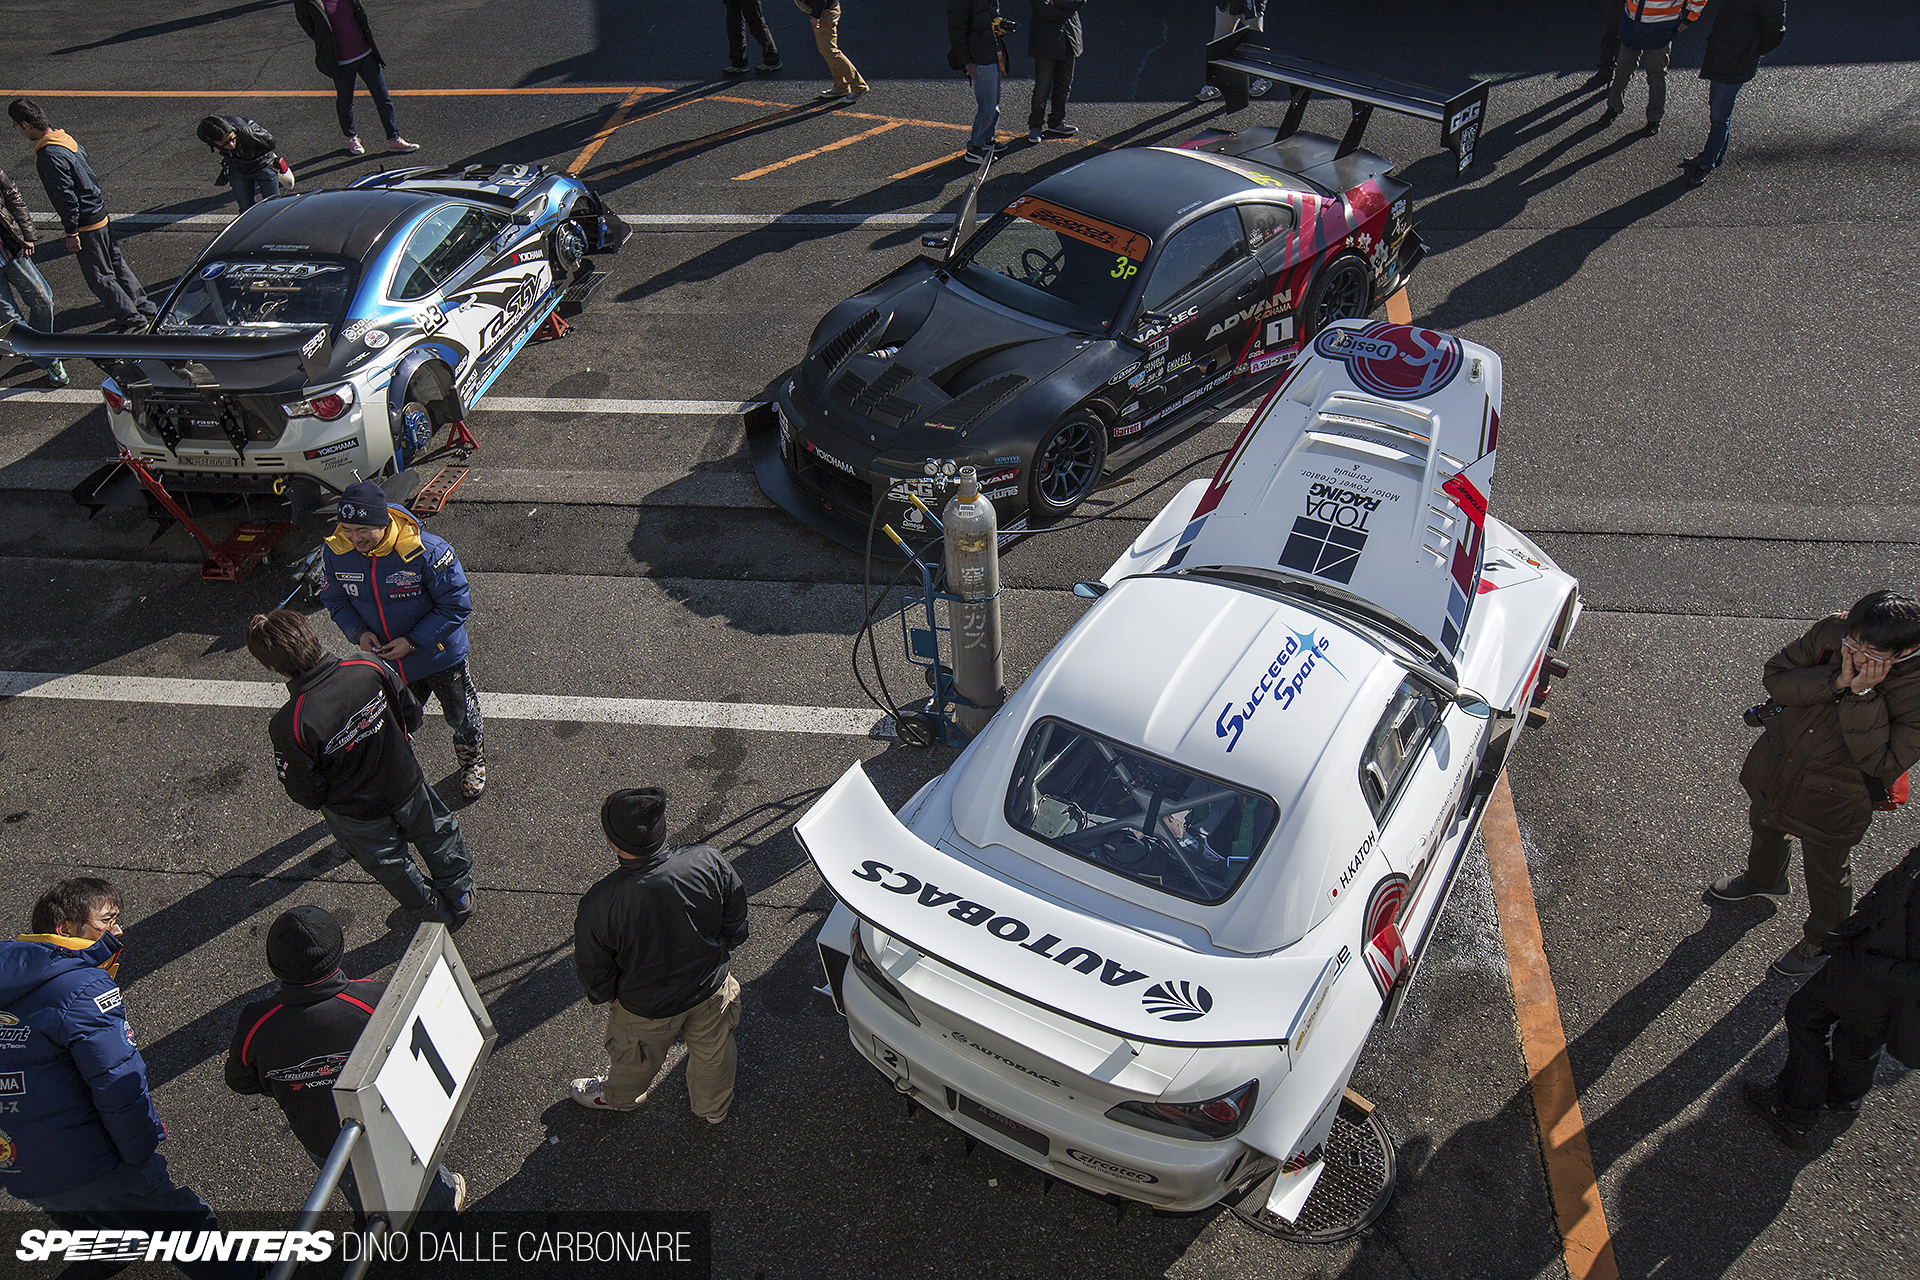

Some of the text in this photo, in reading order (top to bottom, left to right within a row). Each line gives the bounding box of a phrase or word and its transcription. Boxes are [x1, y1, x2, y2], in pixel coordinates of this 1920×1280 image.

[518, 249, 544, 262] YOKOHAMA
[1110, 256, 1138, 280] 3P
[1204, 289, 1292, 341] ADVAN
[1254, 302, 1292, 323] YOKOHAMA
[1113, 423, 1140, 437] Garrett
[316, 440, 357, 456] YOKOHAMA
[814, 446, 857, 476] YOKOHAMA
[1333, 466, 1373, 484] Formula
[1343, 478, 1369, 494] Power
[1309, 482, 1382, 512] RACING
[1371, 486, 1401, 502] Motor
[1306, 495, 1370, 533] TODA
[342, 583, 359, 597] 19
[1273, 636, 1330, 711] Sports
[1215, 636, 1299, 753] Succeed
[1339, 829, 1377, 890] H.KATOH
[851, 859, 1151, 987] AUTOBACS
[409, 1015, 457, 1100] 1
[883, 1048, 899, 1069] 2
[968, 1042, 1062, 1089] AUTOBACS
[1078, 1153, 1148, 1181] zircotec
[1081, 1160, 1141, 1184] heat management
